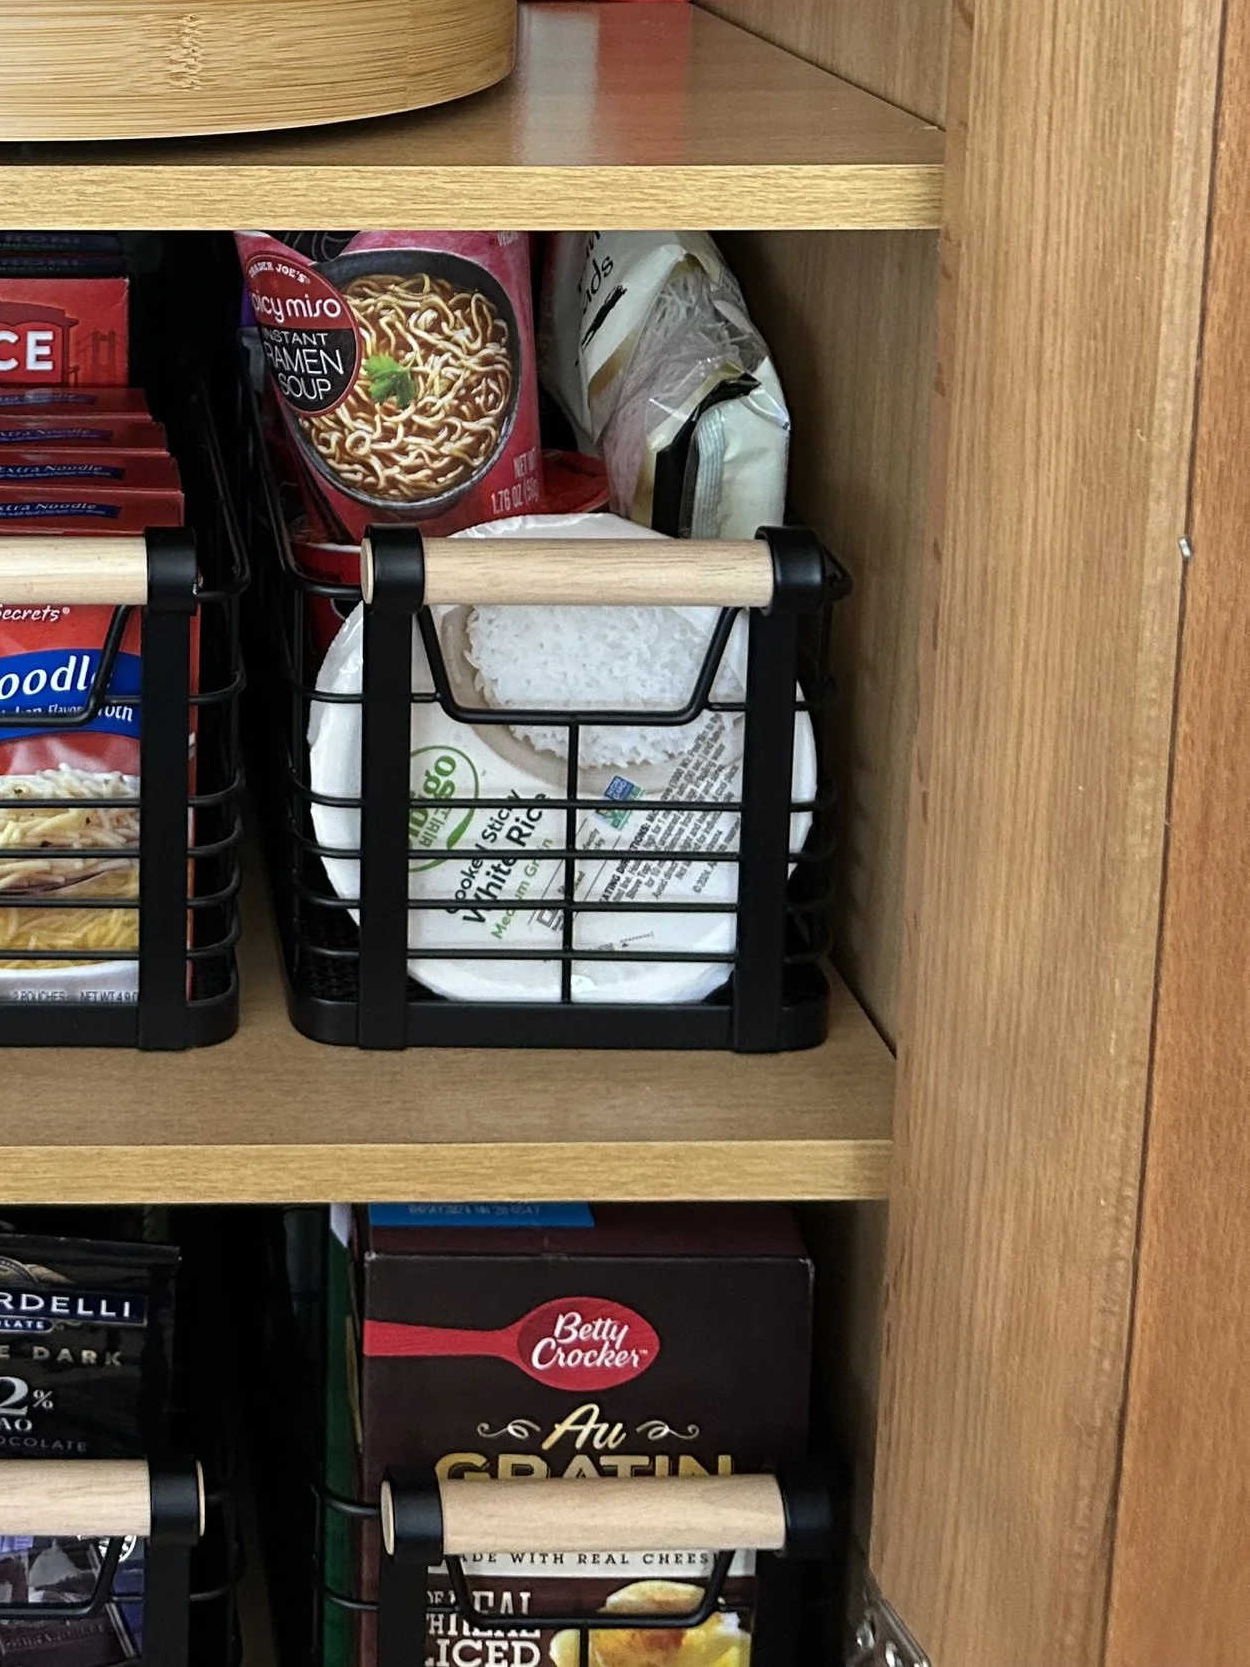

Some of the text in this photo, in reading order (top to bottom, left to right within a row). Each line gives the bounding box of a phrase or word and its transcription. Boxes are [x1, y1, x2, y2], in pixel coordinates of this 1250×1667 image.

[275, 264, 307, 284] JOE'S
[250, 290, 342, 324] picy miso
[261, 326, 329, 346] INSTANT
[264, 340, 345, 375] RAMEN
[277, 371, 332, 400] SOUP
[44, 465, 103, 473] Noodle
[34, 502, 98, 511] Noodle
[491, 483, 523, 514] 1.76 OZ
[444, 788, 521, 915] ooke Sticy
[462, 792, 547, 924] White Rice
[20, 990, 66, 1002] POUCHES
[553, 1310, 630, 1349] Betty
[32, 1344, 123, 1368] DARK
[530, 1336, 641, 1370] Crocker
[541, 1402, 627, 1451] Au
[511, 1552, 630, 1565] WITH REAL
